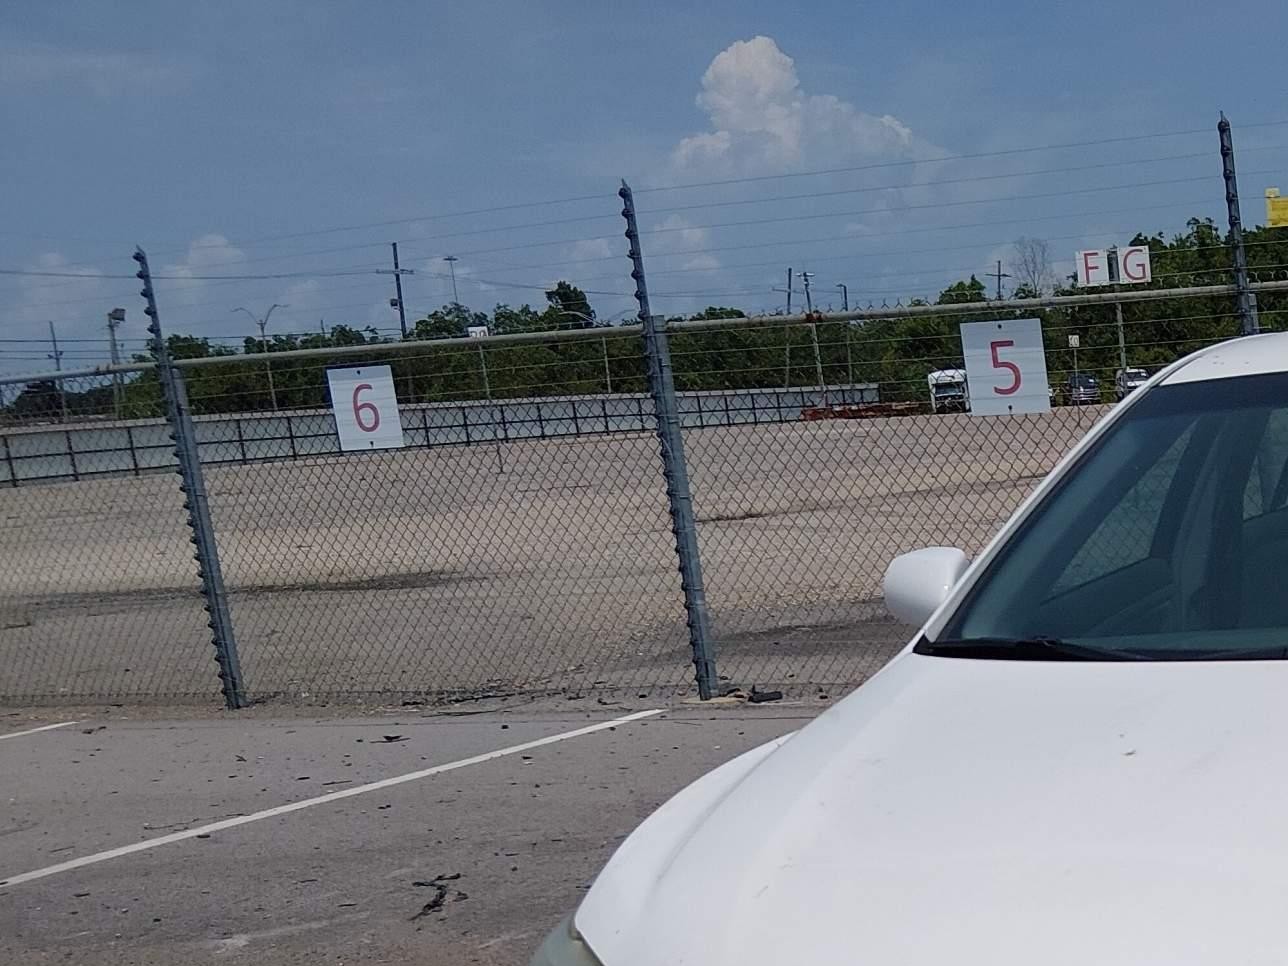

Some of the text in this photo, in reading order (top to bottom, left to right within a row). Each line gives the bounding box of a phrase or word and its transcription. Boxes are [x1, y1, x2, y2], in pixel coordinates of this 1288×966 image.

[1083, 252, 1100, 284] F
[1122, 248, 1147, 280] G
[990, 340, 1022, 395] 5
[352, 383, 380, 433] 6
